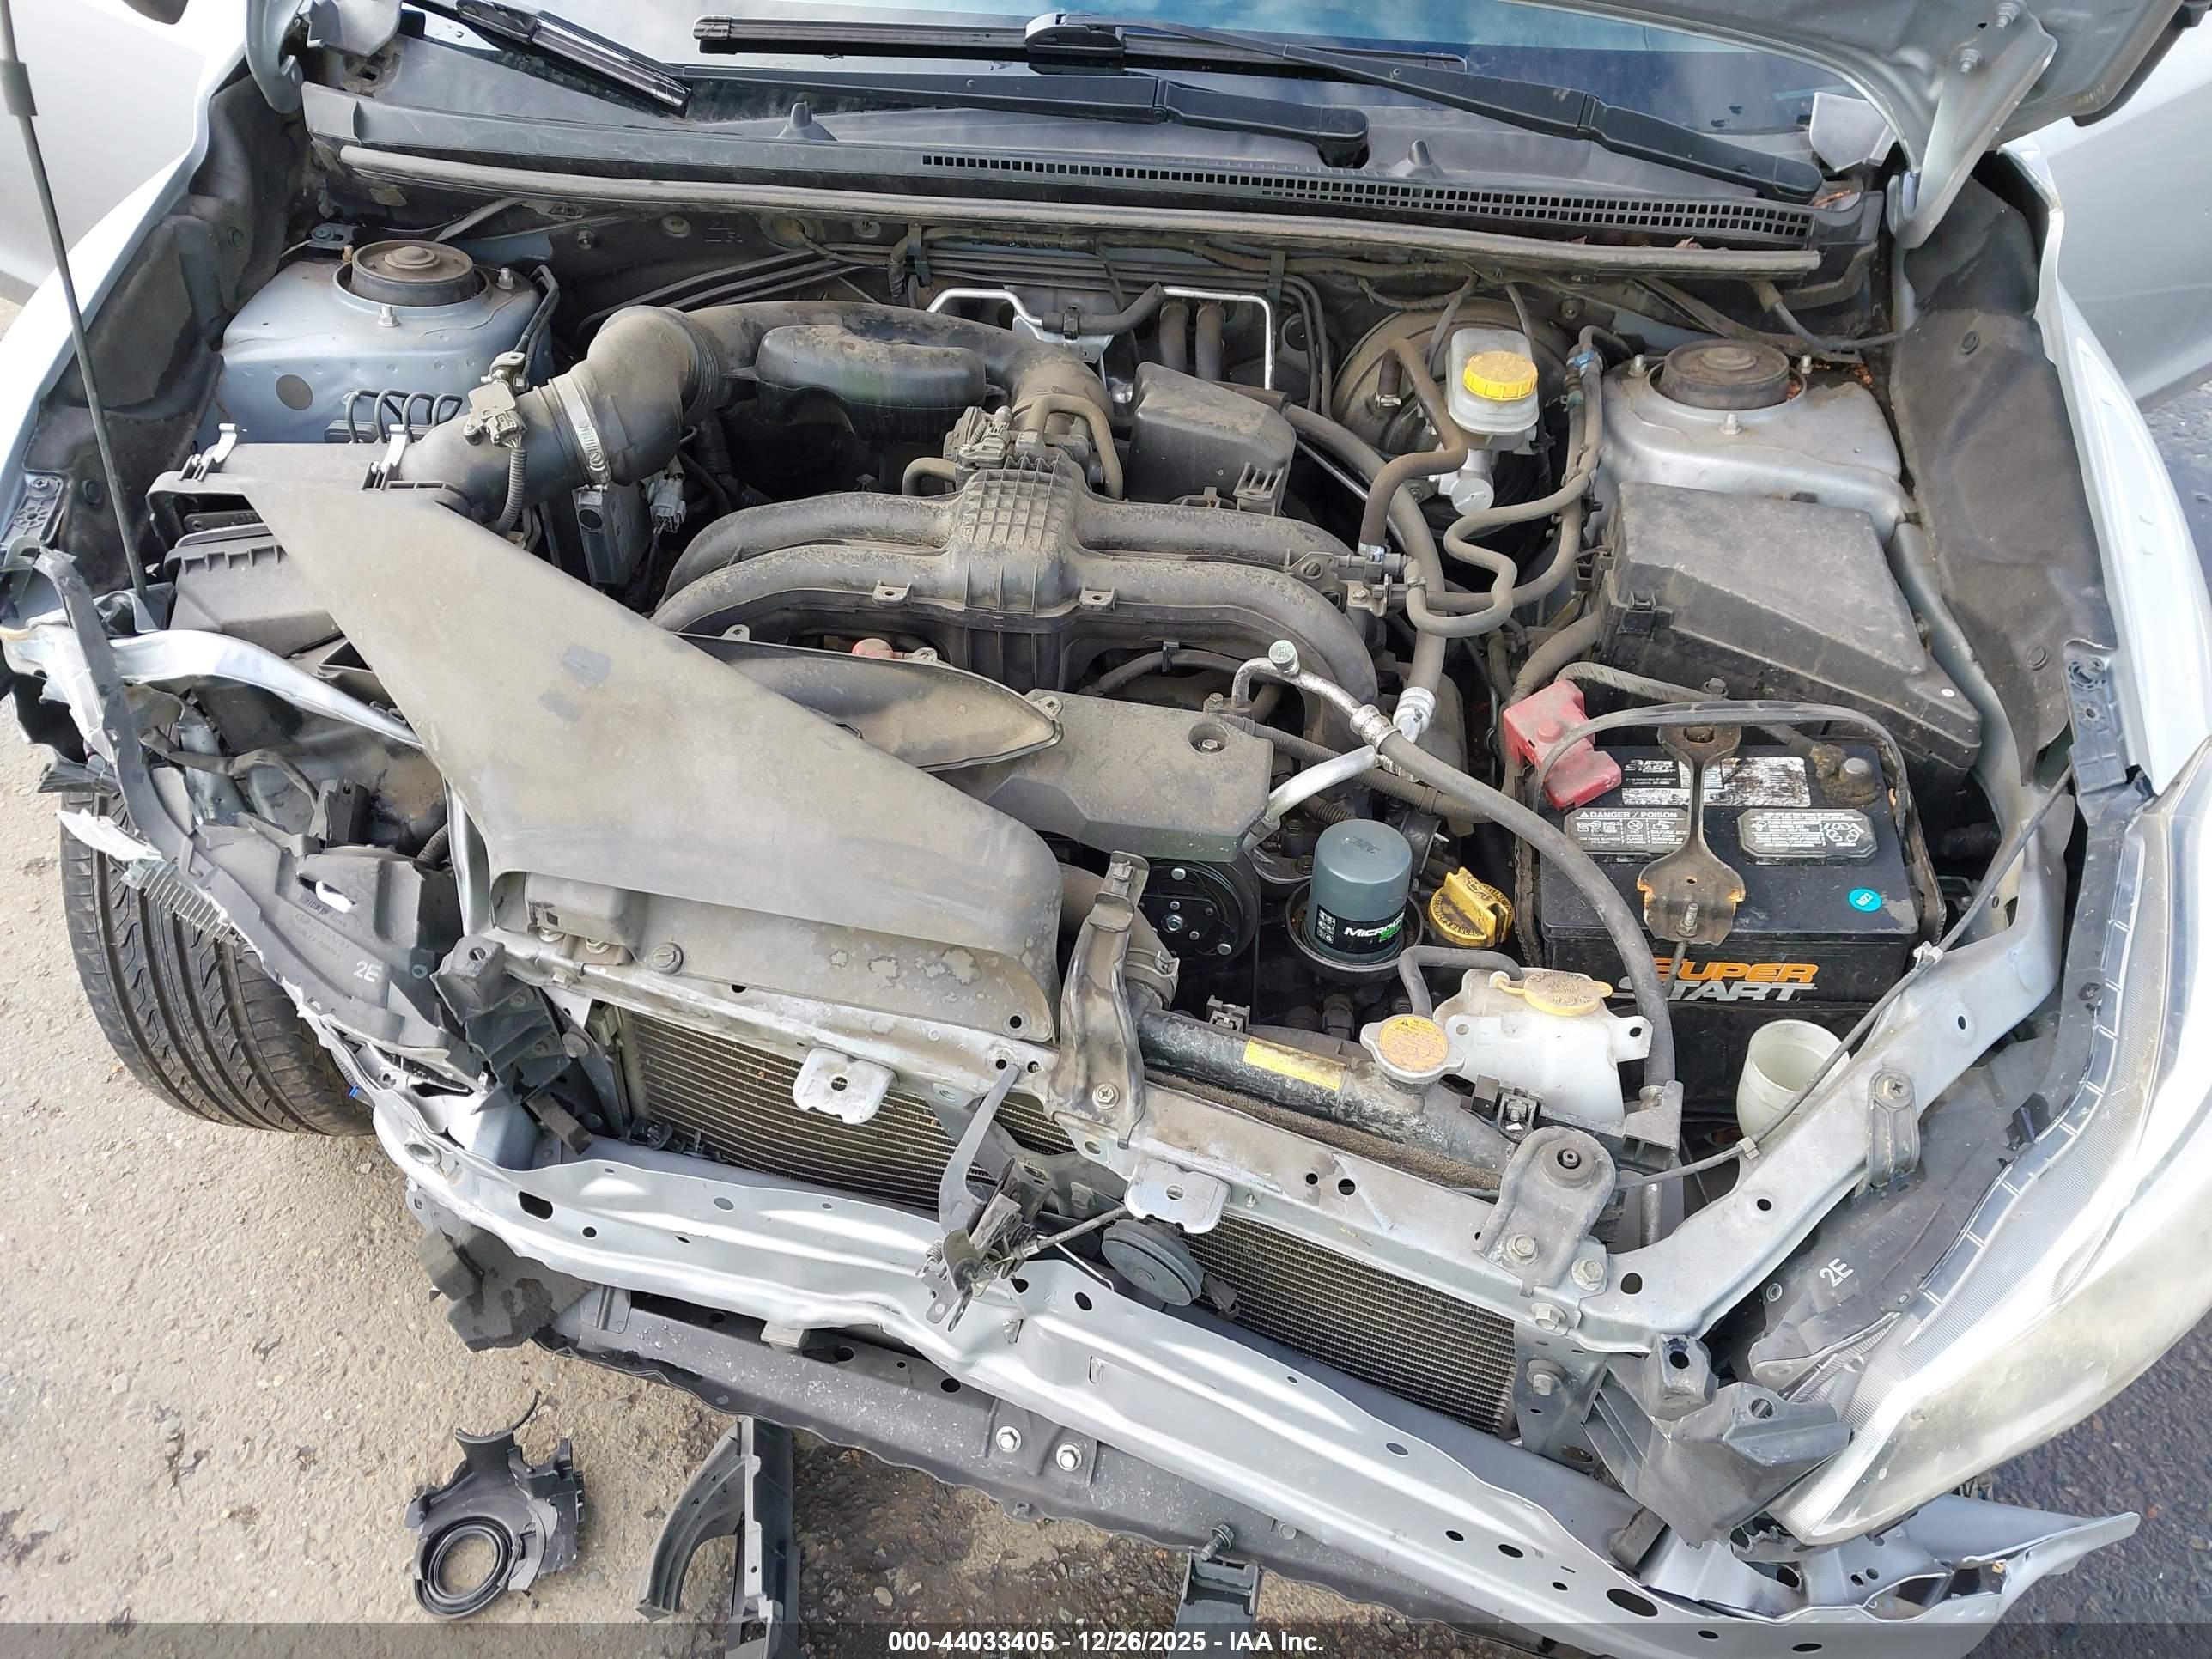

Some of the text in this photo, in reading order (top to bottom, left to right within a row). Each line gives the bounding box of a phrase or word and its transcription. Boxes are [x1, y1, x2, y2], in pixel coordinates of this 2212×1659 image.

[1449, 922, 1478, 936] MANUAL
[353, 960, 383, 983] 2E
[1819, 1257, 1854, 1288] 2E
